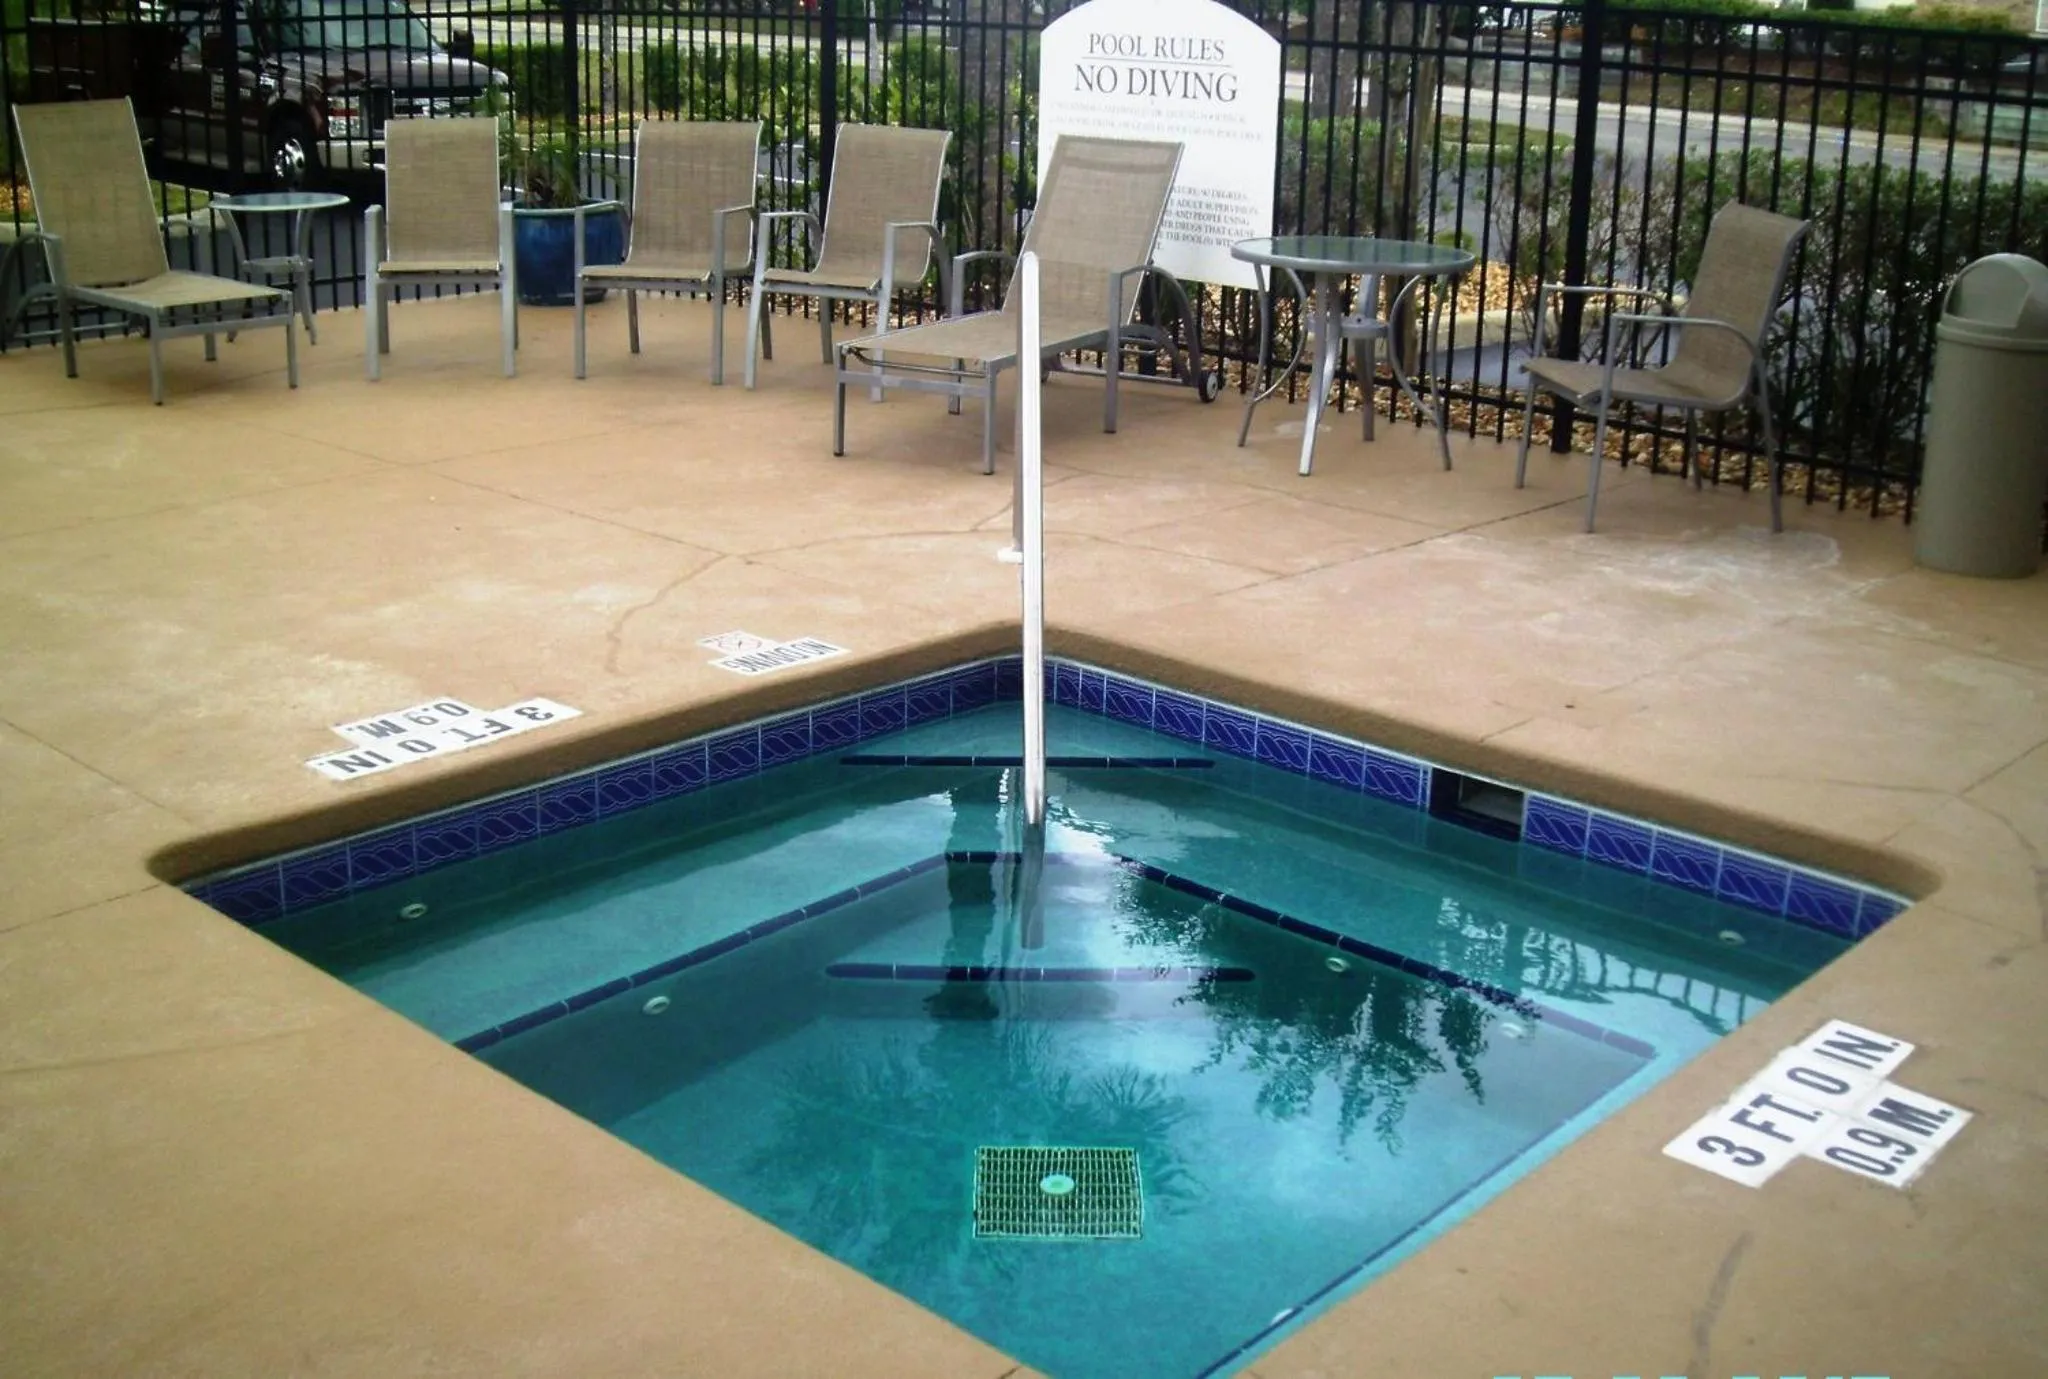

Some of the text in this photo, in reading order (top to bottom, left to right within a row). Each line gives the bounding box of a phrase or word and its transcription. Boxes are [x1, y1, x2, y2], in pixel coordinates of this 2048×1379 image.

[1089, 33, 1226, 62] POOL RULES
[1074, 64, 1239, 103] NO DIVING
[1203, 224, 1226, 234] THAT
[319, 705, 554, 773] 3 FT. 0 IN.
[347, 702, 470, 739] 0.9 M.
[1697, 1030, 1901, 1167] 3 FT. 0 IN.
[1824, 1097, 1955, 1177] 0.9 M.
